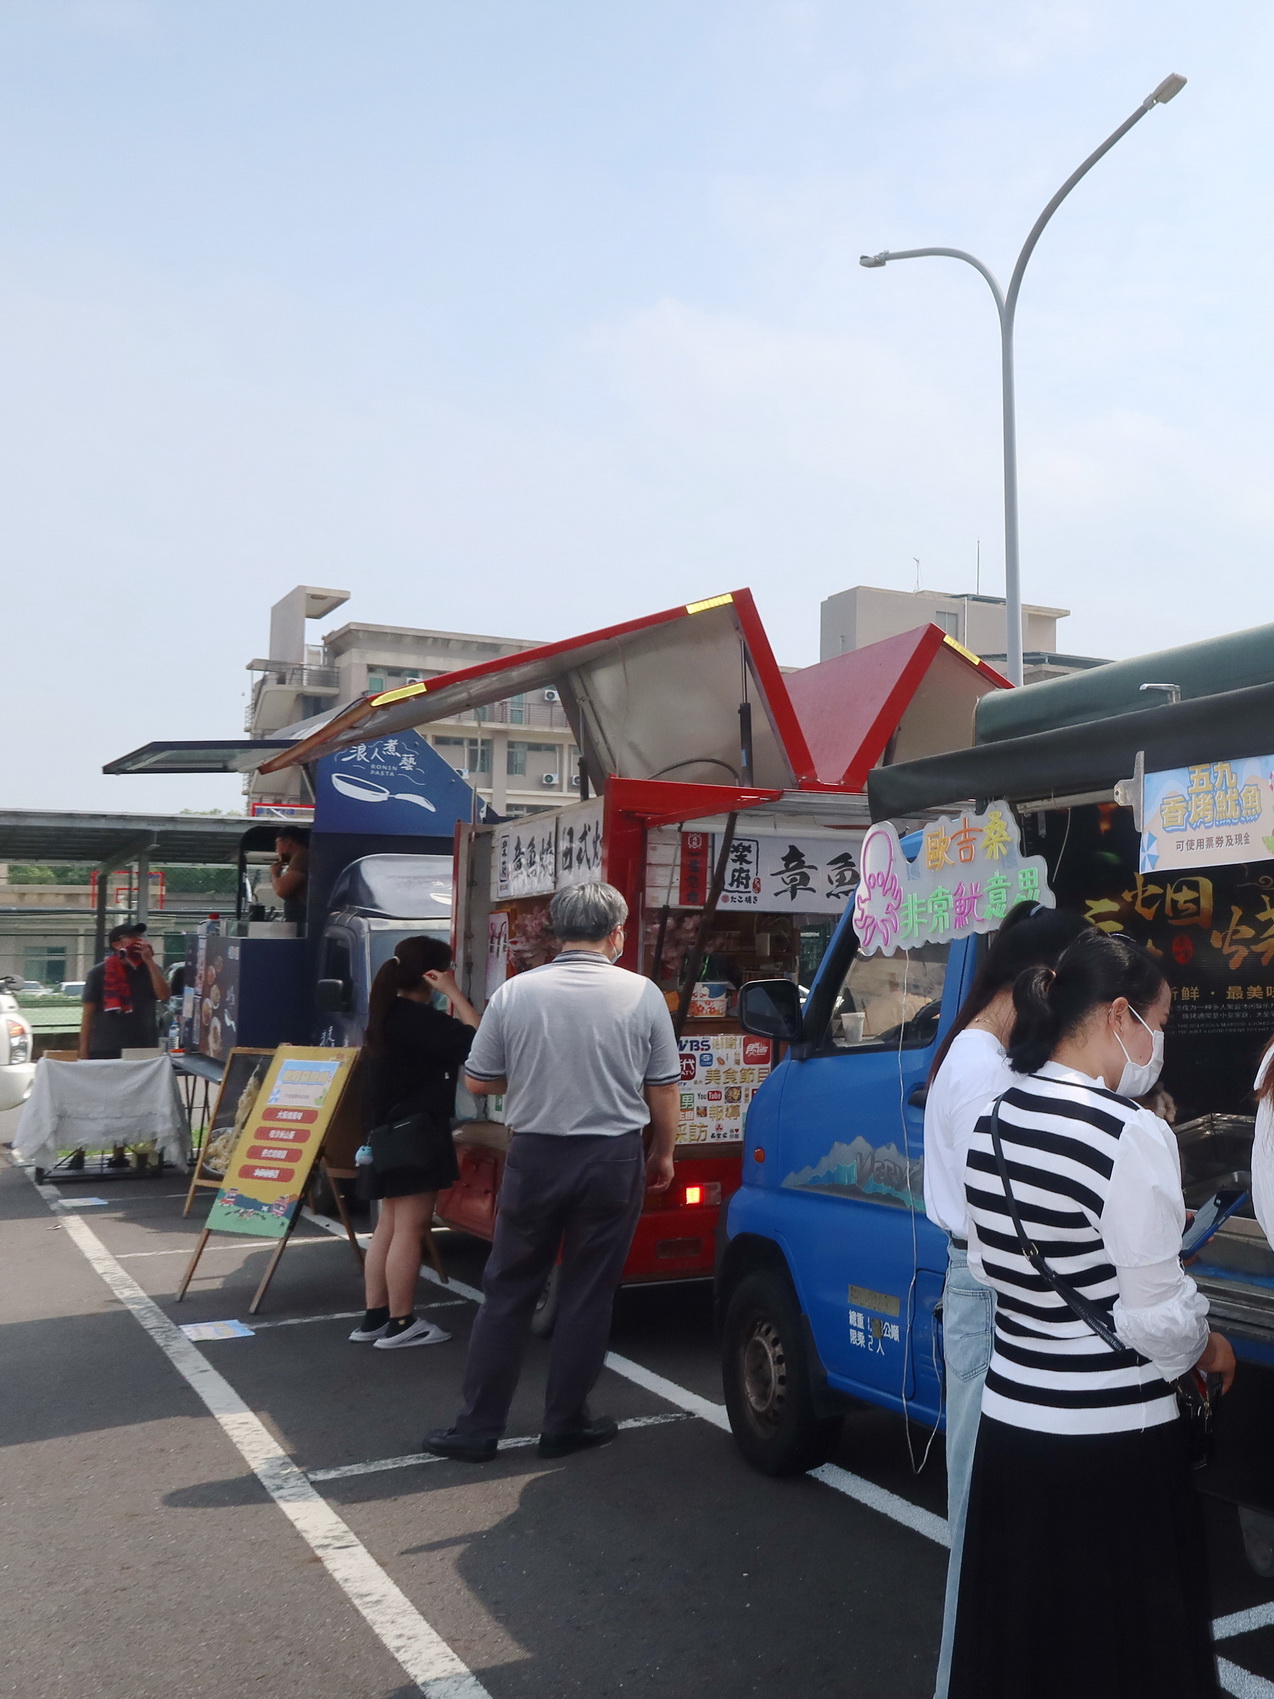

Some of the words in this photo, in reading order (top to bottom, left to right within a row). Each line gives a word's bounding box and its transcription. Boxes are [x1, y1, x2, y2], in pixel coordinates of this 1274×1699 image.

[341, 738, 418, 772] 浪人煮藝
[370, 763, 398, 771] RONIN
[1187, 760, 1238, 795] 五九
[1160, 785, 1263, 830] 香烤魷魚
[924, 810, 1012, 871] 歐吉桑
[1175, 832, 1251, 852] 可使用票券及現金
[769, 844, 861, 901] 章魚
[901, 867, 1040, 939] 非常魷意思
[678, 1039, 711, 1052] VBS
[704, 1067, 771, 1085] 美食節目
